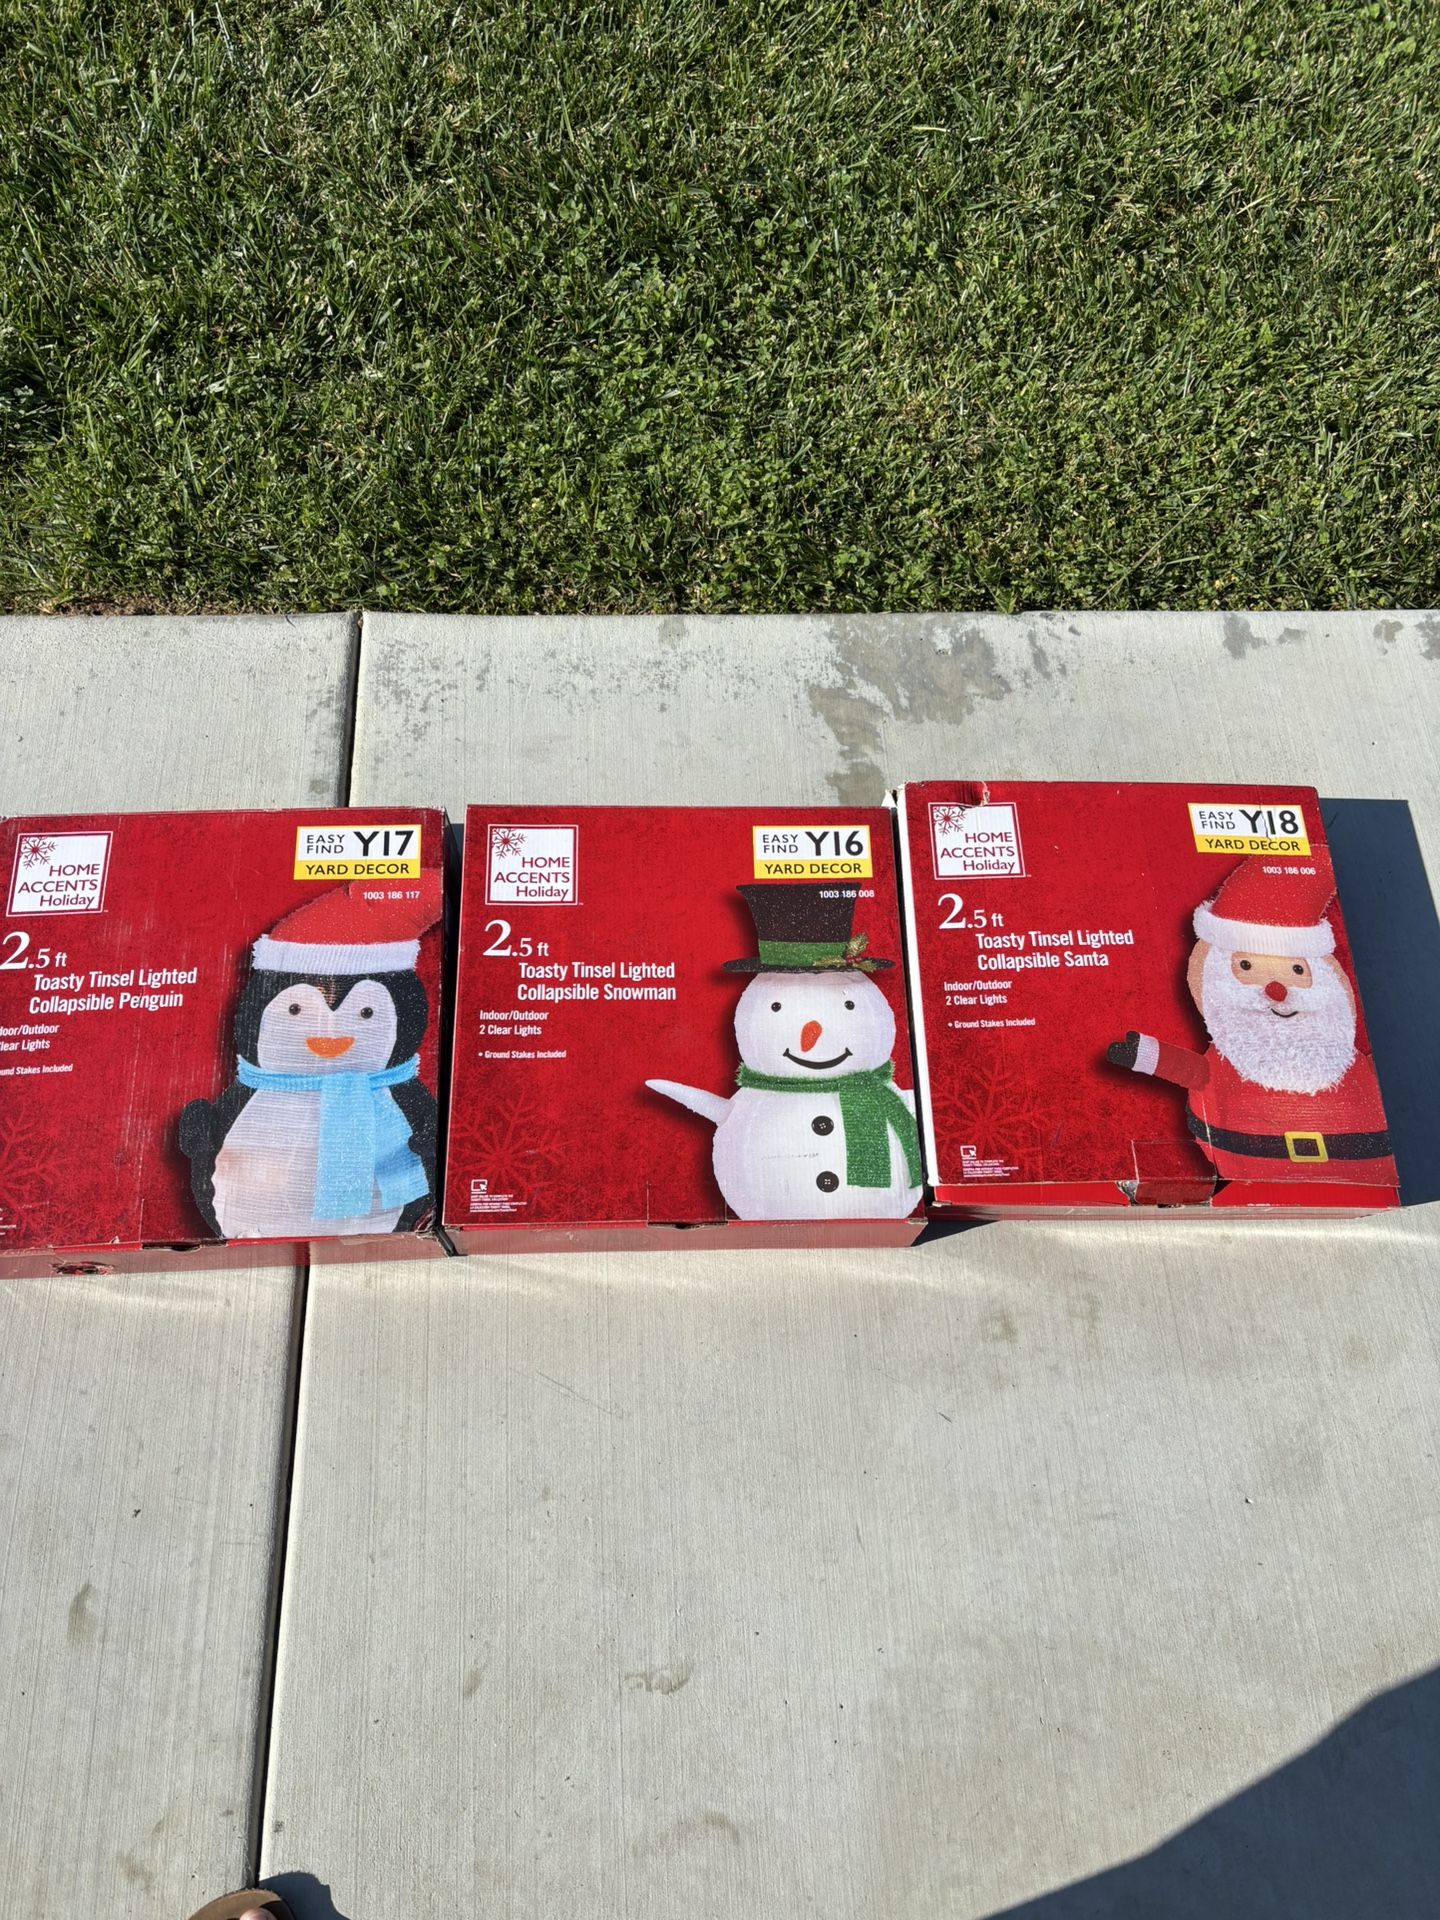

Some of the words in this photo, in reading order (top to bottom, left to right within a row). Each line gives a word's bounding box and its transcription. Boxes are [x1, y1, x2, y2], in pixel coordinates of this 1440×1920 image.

[1198, 811, 1234, 820] EASY
[1201, 821, 1236, 830] FIND
[306, 834, 345, 844] EASY
[762, 834, 799, 843] EASY
[965, 832, 1013, 843] HOME
[306, 845, 344, 854] FIND
[763, 844, 799, 853] FIND
[1205, 838, 1245, 849] YARD
[1249, 840, 1301, 851] DECOR
[940, 846, 1015, 858] ACCENTS
[522, 857, 570, 868] HOME
[764, 864, 805, 874] YARD
[809, 863, 863, 874] DECOR
[963, 859, 1015, 874] Holiday
[49, 863, 101, 877] HOME
[305, 864, 349, 875] YARD
[354, 863, 410, 875] DECOR
[1262, 866, 1282, 874] 1003
[1284, 867, 1299, 875] 186
[1300, 867, 1316, 875] 006
[494, 872, 570, 883] ACCENTS
[18, 879, 98, 893] ACCENTS
[363, 891, 385, 900] 1003
[387, 891, 403, 899] 186
[406, 890, 420, 899] 117
[516, 886, 569, 902] Holiday
[819, 890, 840, 898] 1003
[842, 890, 857, 898] 186
[858, 889, 875, 898] 008
[39, 893, 95, 910] Holiday
[937, 893, 987, 929] 2.5
[991, 913, 1004, 928] ft
[483, 919, 533, 957] 2.5
[536, 942, 549, 957] ft
[975, 932, 1025, 950] Toasty
[1028, 930, 1073, 947] Tinsel
[1077, 929, 1134, 949] Lighted
[0, 931, 50, 971] 2.5
[54, 952, 68, 968] ft
[977, 952, 1060, 972] Collapsible
[1064, 951, 1109, 967] Santa
[518, 962, 568, 981] Toasty
[572, 961, 615, 979] Tinsel
[620, 962, 675, 981] Lighted
[34, 973, 85, 992] Toasty
[89, 969, 135, 988] Tinsel
[138, 967, 198, 988] Lighted
[944, 980, 1013, 991] Indoor/Outdoor
[517, 984, 599, 1003] Collapsible
[603, 983, 676, 1001] Snowman
[29, 993, 114, 1015] Collapsible
[118, 990, 184, 1011] Penguin
[945, 995, 952, 1005] 2
[953, 995, 978, 1005] Clear
[979, 994, 1008, 1006] Lights
[479, 1010, 550, 1020] Indoor/Outdoor
[954, 1020, 980, 1028] Ground
[980, 1019, 1005, 1028] Stakes
[1005, 1018, 1036, 1027] Included
[479, 1024, 486, 1035] 2
[487, 1024, 512, 1035] Clear
[514, 1024, 542, 1037] Lights
[21, 1039, 51, 1052] Lights
[484, 1050, 510, 1059] Ground
[511, 1050, 536, 1059] Stakes
[536, 1050, 567, 1059] Included
[15, 1065, 41, 1075] Stakes
[42, 1063, 74, 1073] Included
